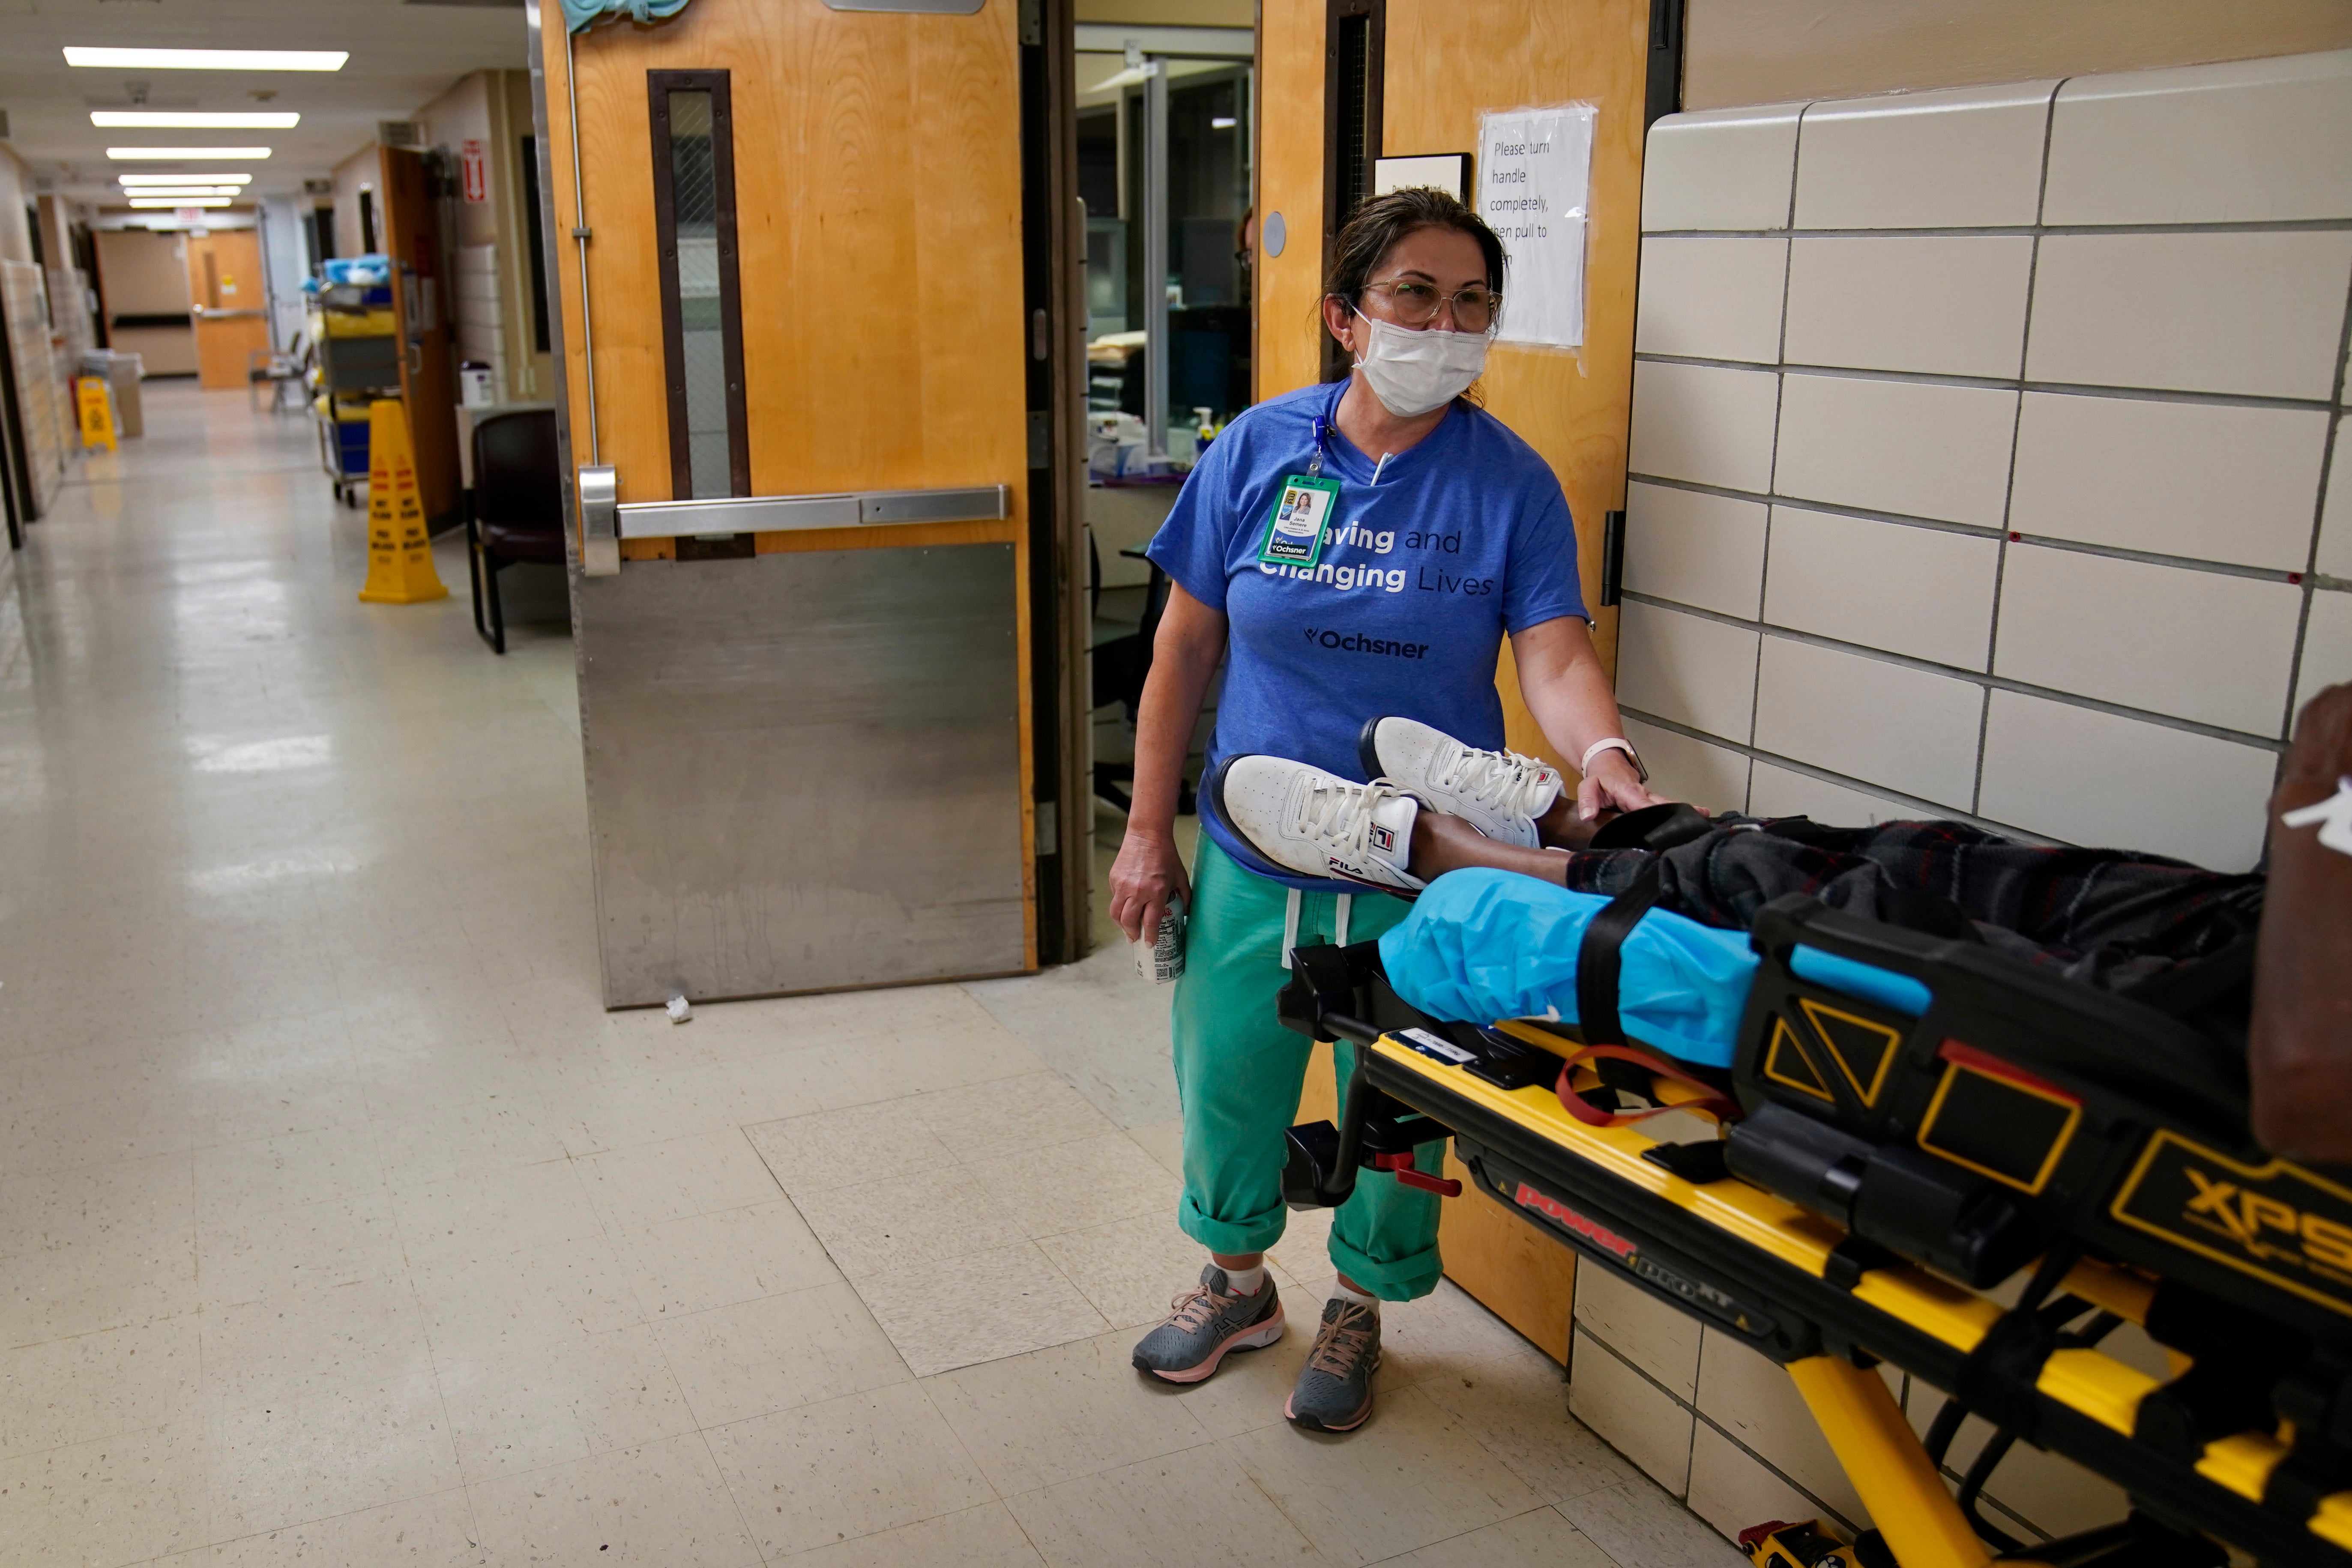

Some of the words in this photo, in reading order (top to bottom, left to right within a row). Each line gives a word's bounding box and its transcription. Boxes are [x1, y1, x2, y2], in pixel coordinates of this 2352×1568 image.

[1494, 142, 1525, 156] Please
[1530, 141, 1550, 154] turn
[1492, 168, 1526, 183] handle
[1490, 195, 1548, 214] completely,
[1515, 223, 1534, 241] pull
[1537, 224, 1547, 238] to
[1323, 521, 1395, 554] aving
[1405, 531, 1461, 554] and
[1276, 546, 1306, 554] Ochsner
[1418, 567, 1494, 595] Lives
[1320, 630, 1429, 659] Ochsner
[1329, 857, 1363, 875] FILA
[1163, 909, 1173, 917] ke
[2184, 1166, 2352, 1270] XPS
